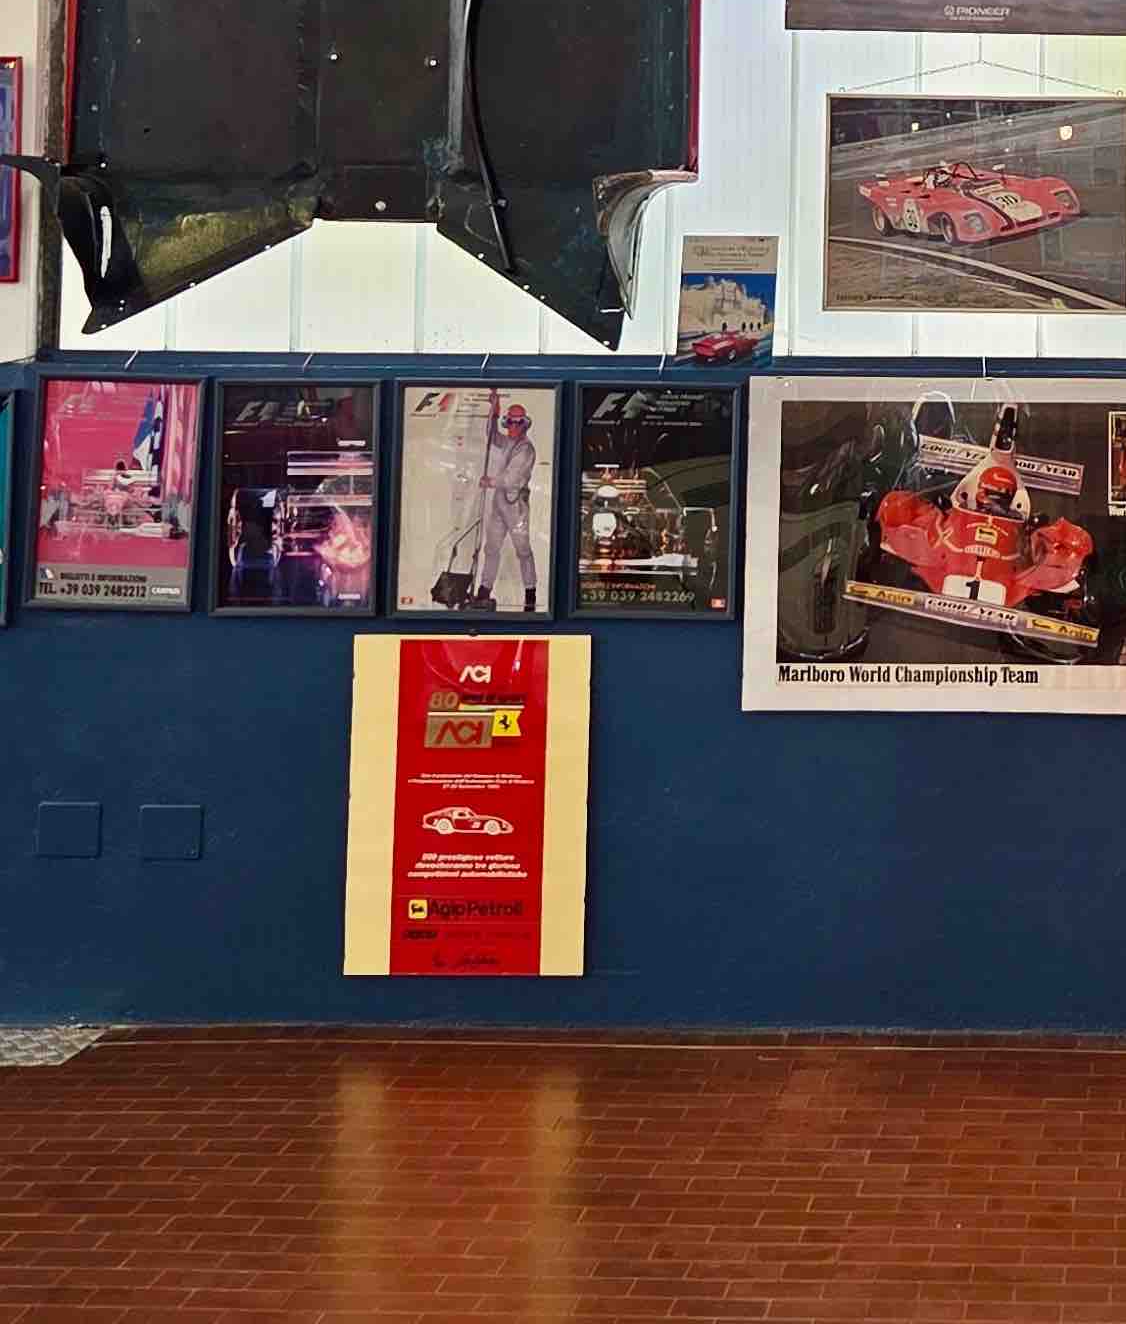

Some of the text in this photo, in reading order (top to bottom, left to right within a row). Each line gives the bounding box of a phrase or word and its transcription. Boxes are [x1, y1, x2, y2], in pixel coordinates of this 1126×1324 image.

[415, 392, 456, 413] F1
[39, 582, 57, 595] TEL.
[60, 583, 79, 596] +39
[81, 584, 100, 596] 039
[459, 665, 492, 683] ACI
[778, 665, 1039, 686] Marlboro World Championship Team
